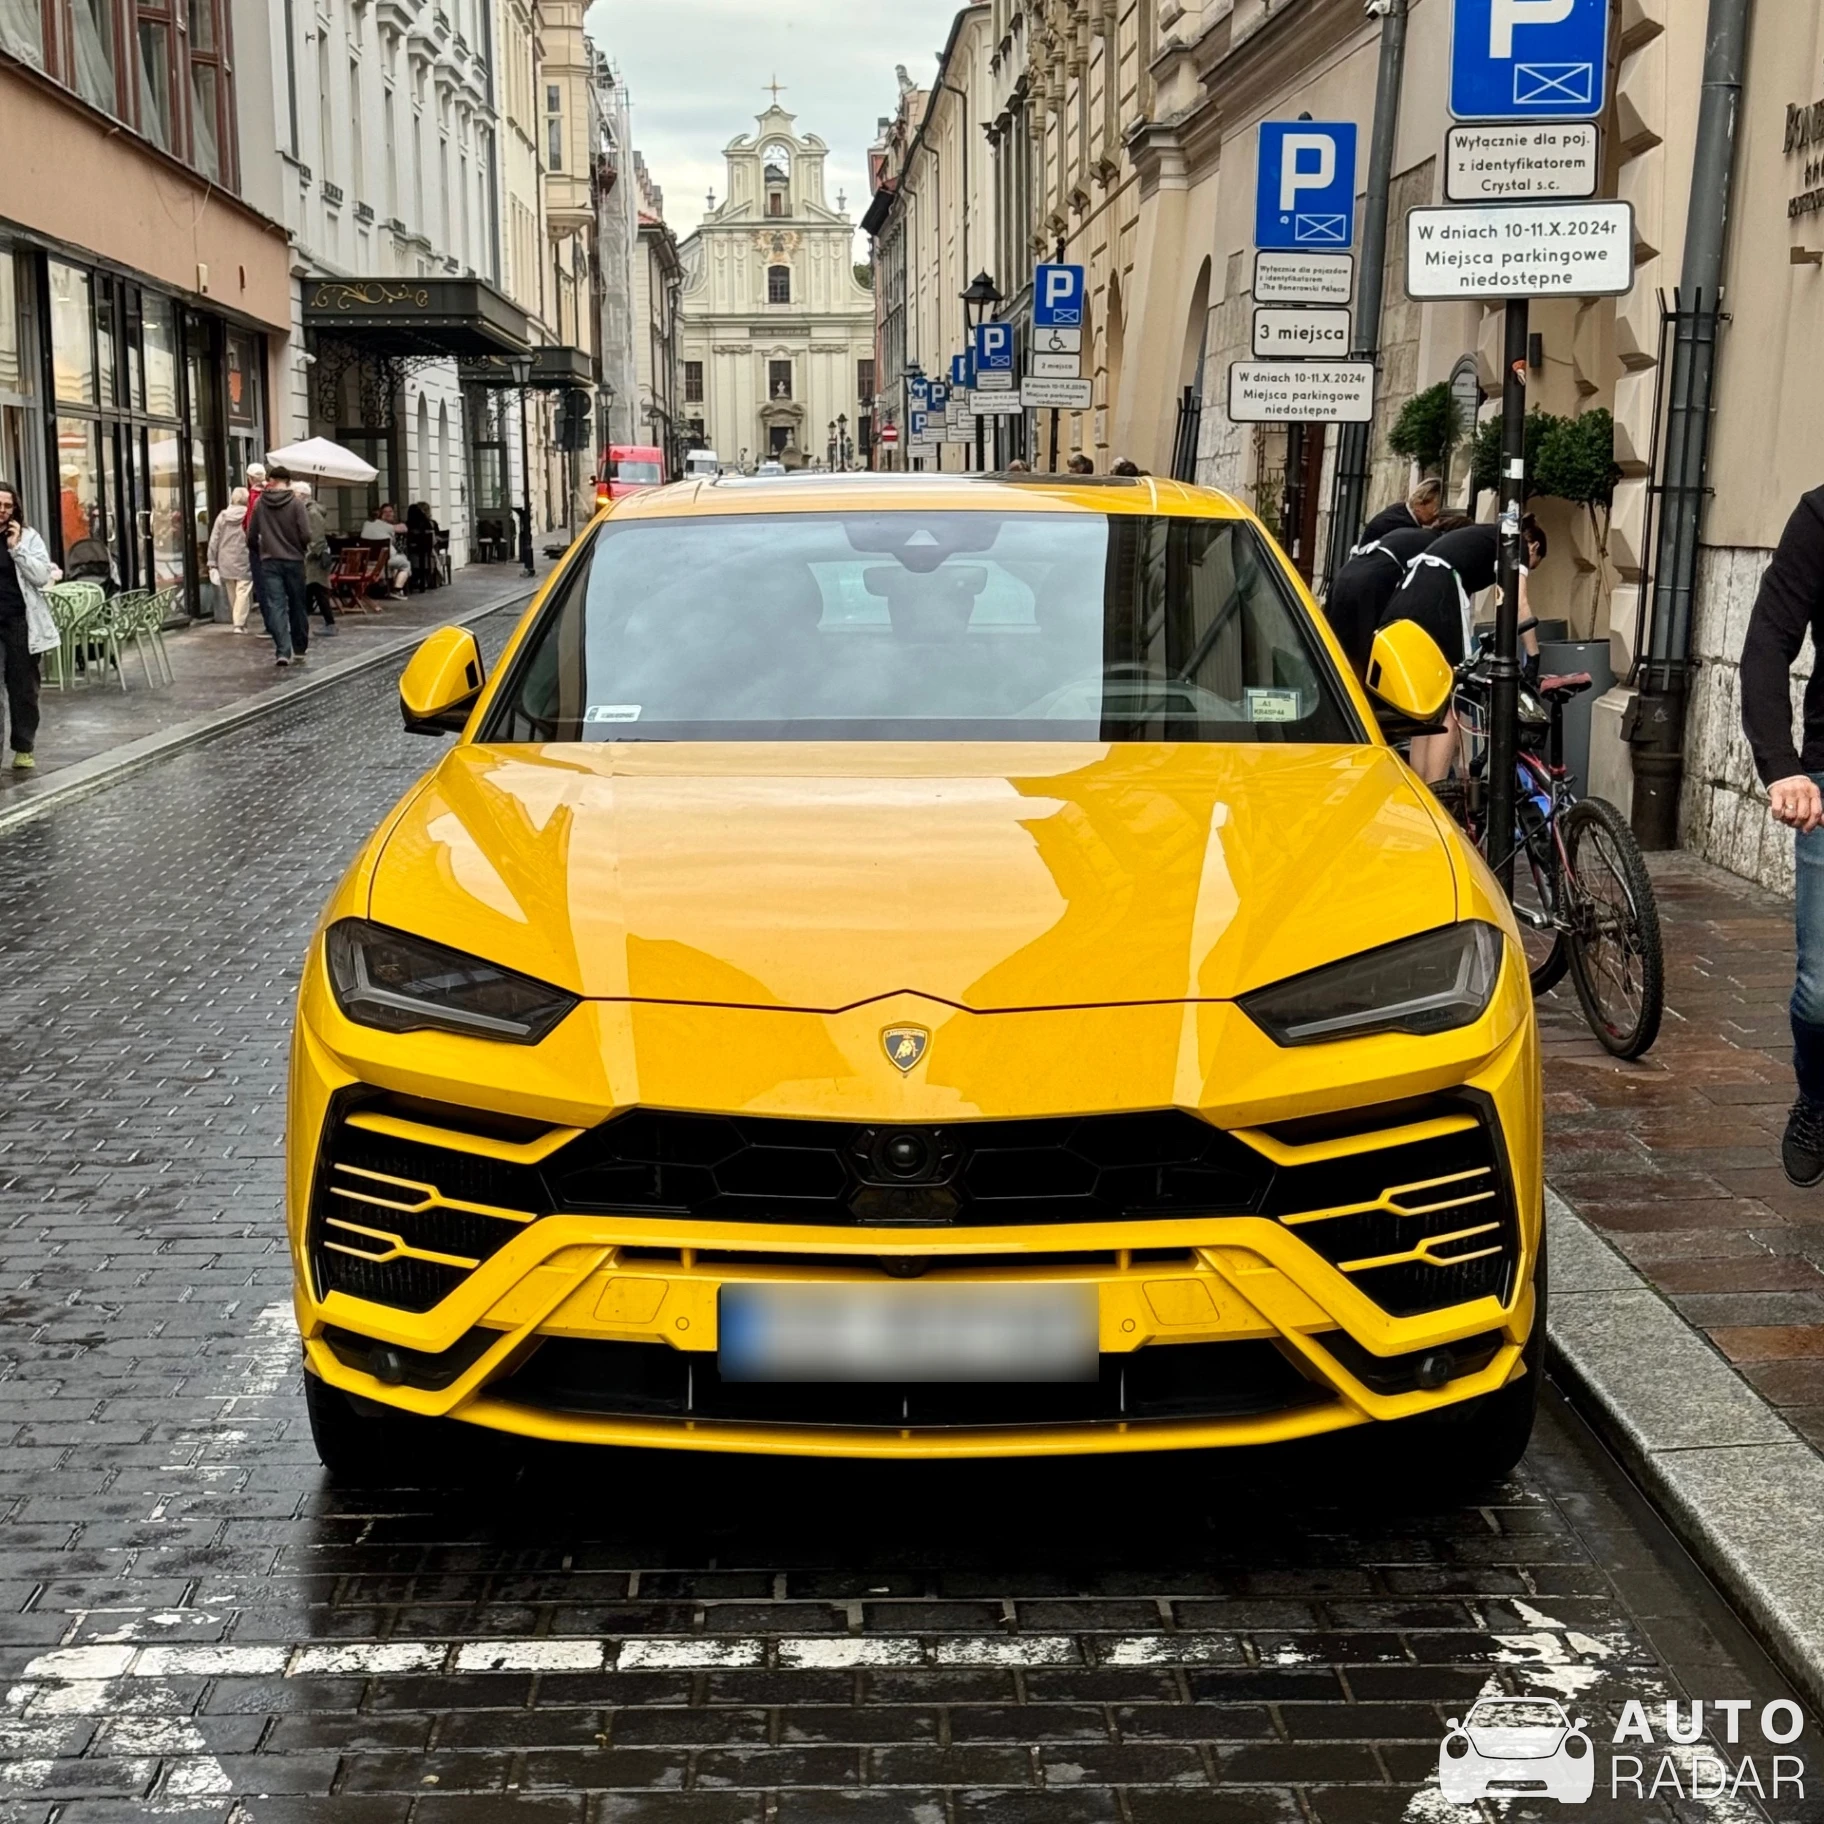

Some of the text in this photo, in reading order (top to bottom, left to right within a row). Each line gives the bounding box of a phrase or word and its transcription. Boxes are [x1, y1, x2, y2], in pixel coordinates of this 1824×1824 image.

[1455, 131, 1590, 151] Wyłącznie dla poj.
[1279, 134, 1336, 211] P
[1458, 157, 1585, 174] z identyfikatorem
[1481, 178, 1560, 194] Crystal s.c.
[1417, 220, 1617, 240] W dniach 10-11.X.2024r
[1425, 248, 1608, 268] Miejsca parkingowe
[1046, 270, 1074, 308] P
[1459, 272, 1573, 289] niedostępne
[984, 328, 1005, 356] P
[1260, 324, 1344, 344] 3 miejsca
[1239, 372, 1366, 383] W dniach 10-11.X.2024r
[931, 384, 945, 403] P
[1243, 389, 1360, 403] Miejsca parkingowe
[1265, 404, 1338, 417] niedostępne
